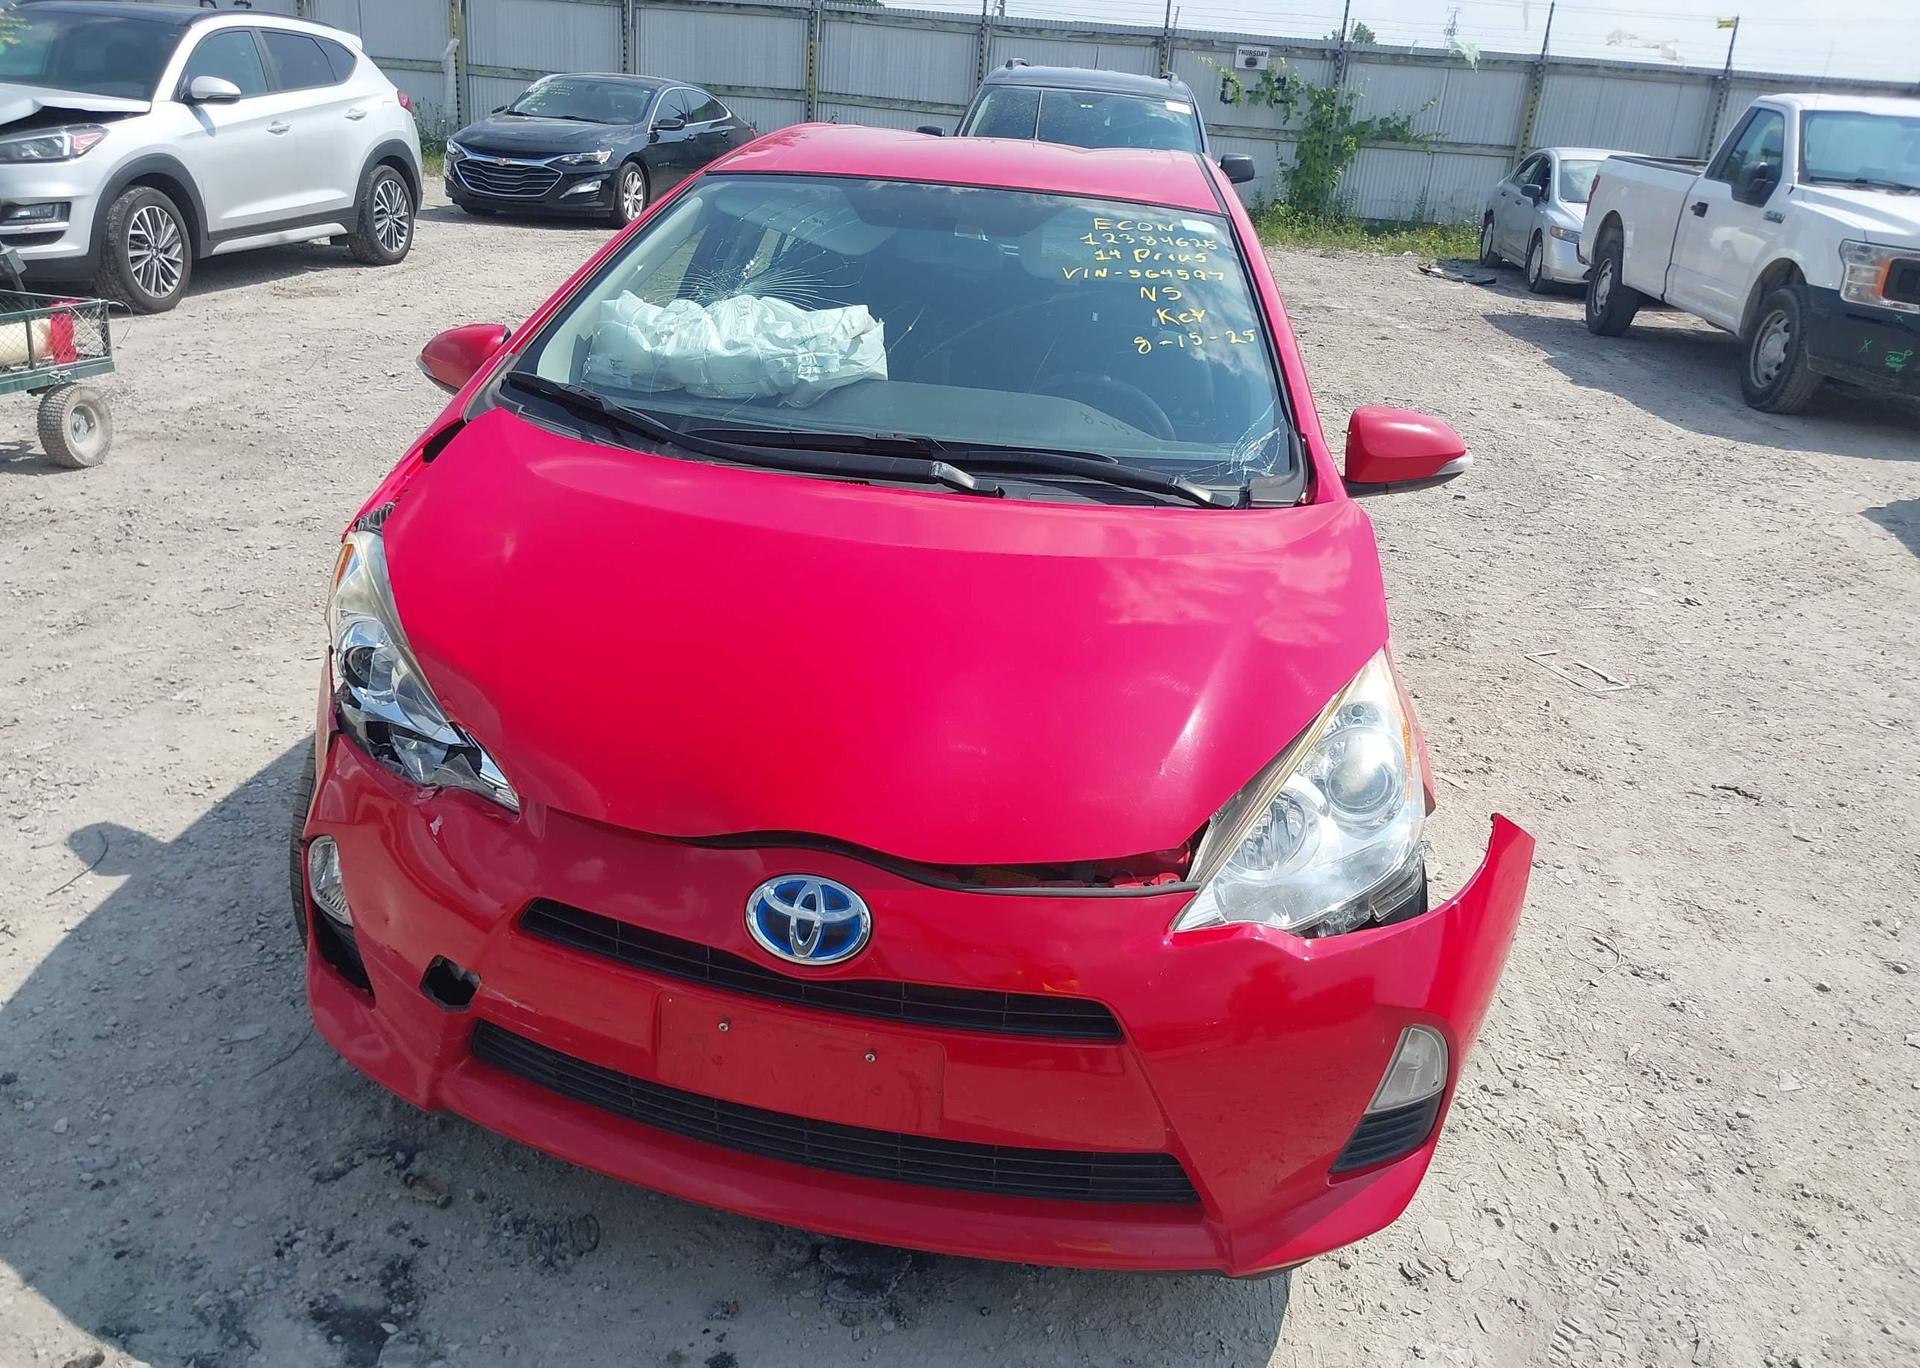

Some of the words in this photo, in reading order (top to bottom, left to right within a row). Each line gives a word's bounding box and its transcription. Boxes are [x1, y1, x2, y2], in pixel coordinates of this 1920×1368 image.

[1238, 49, 1268, 57] THURSDAY
[1093, 217, 1176, 232] ECON
[1140, 286, 1183, 303] NS
